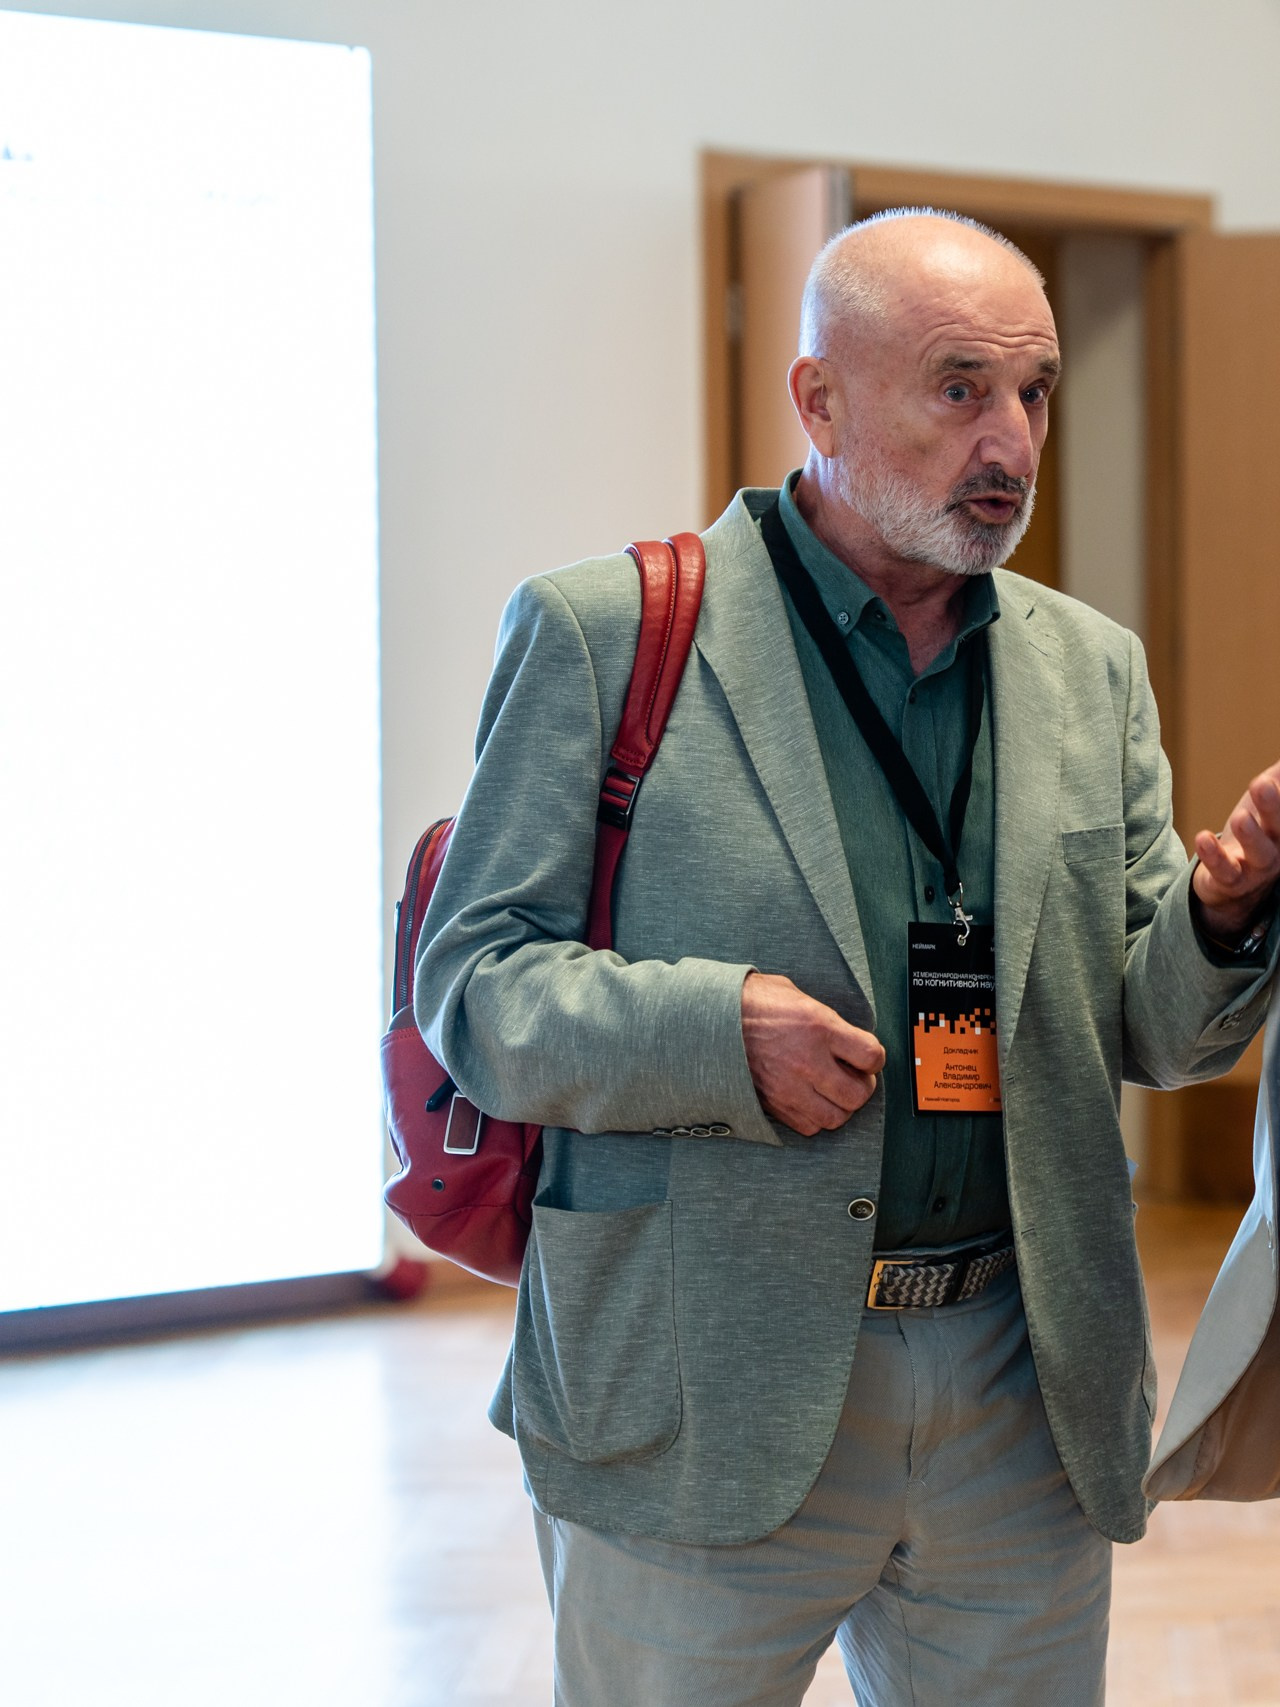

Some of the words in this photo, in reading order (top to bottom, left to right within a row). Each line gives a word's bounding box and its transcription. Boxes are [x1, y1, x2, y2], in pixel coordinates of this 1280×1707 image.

[920, 971, 968, 979] МЕЖДУНАРОДНАЯ
[943, 1046, 979, 1055] Докладчик
[945, 1063, 978, 1073] Антонец
[943, 1072, 980, 1082] Владимир
[934, 1081, 992, 1091] Александрович
